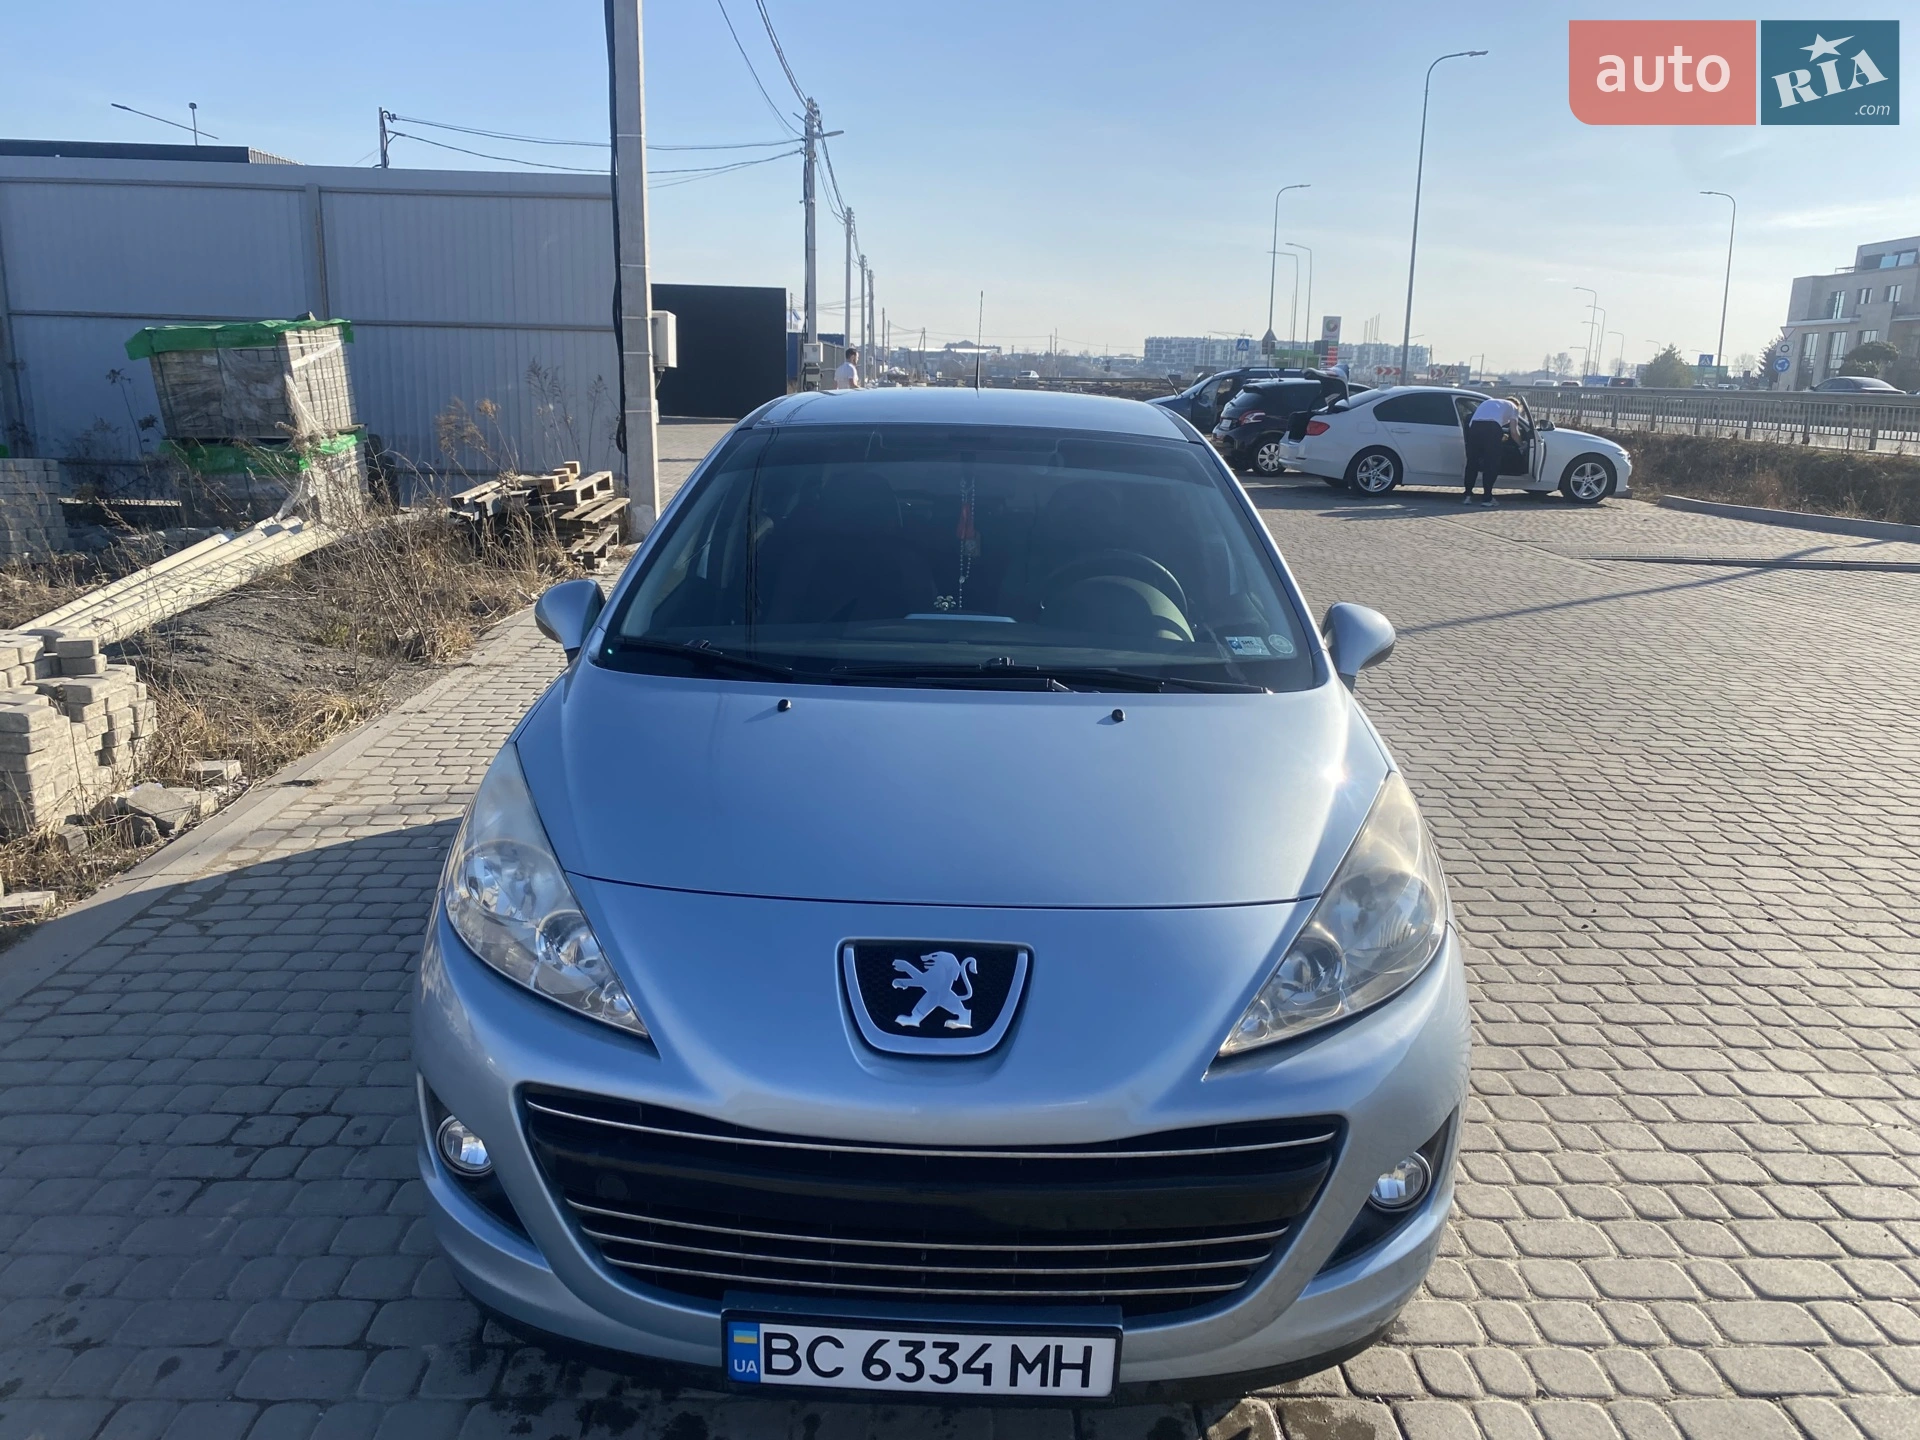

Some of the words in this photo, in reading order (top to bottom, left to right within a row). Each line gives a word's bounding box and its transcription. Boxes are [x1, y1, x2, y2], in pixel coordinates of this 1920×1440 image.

[733, 1358, 758, 1374] UA
[763, 1331, 845, 1378] BC
[861, 1338, 993, 1387] 6334
[1009, 1343, 1093, 1388] MH
